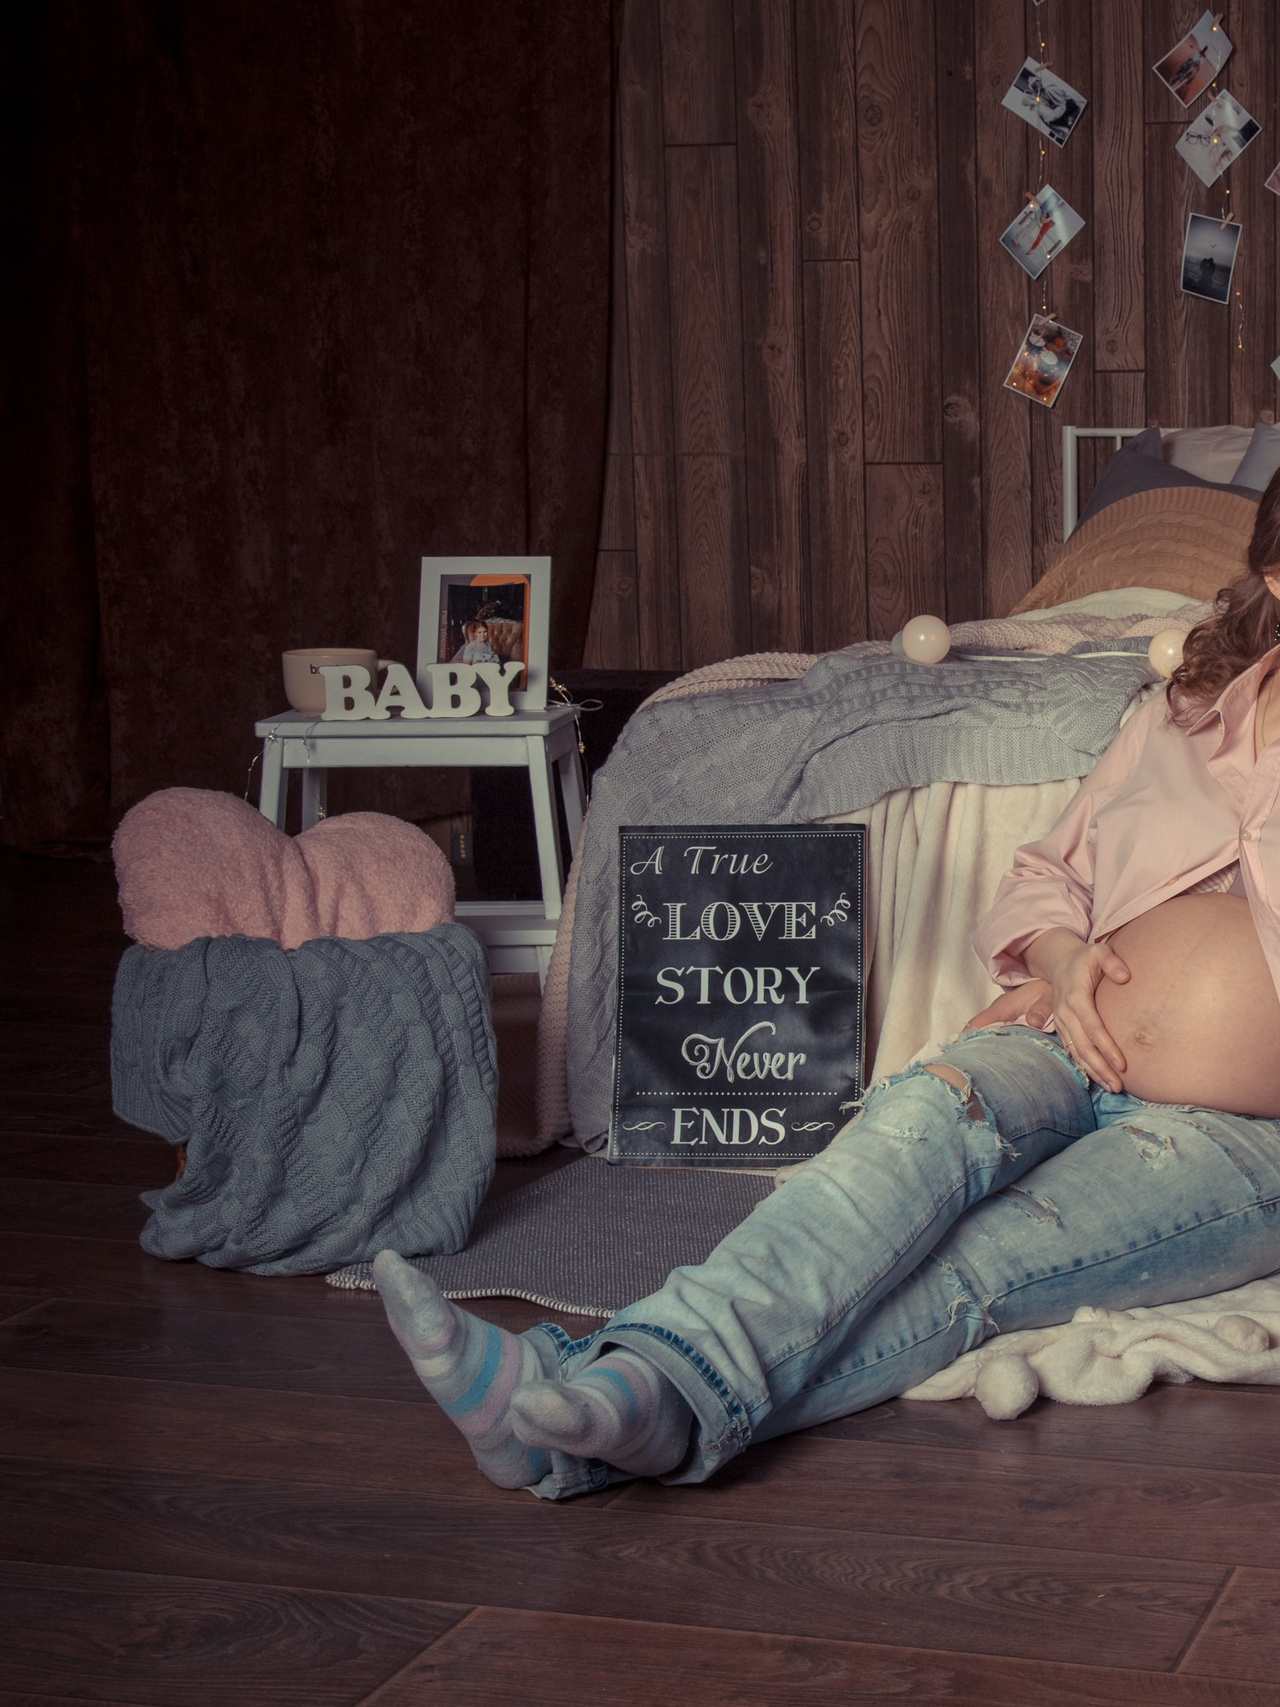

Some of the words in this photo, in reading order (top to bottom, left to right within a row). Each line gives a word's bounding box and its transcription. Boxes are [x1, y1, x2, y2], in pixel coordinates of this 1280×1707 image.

[321, 662, 525, 721] BABY
[630, 846, 665, 875] A
[684, 846, 774, 875] True
[662, 901, 817, 941] LOVE
[655, 966, 821, 1005] STORY
[681, 1021, 806, 1083] Never
[670, 1107, 787, 1146] ENDS
